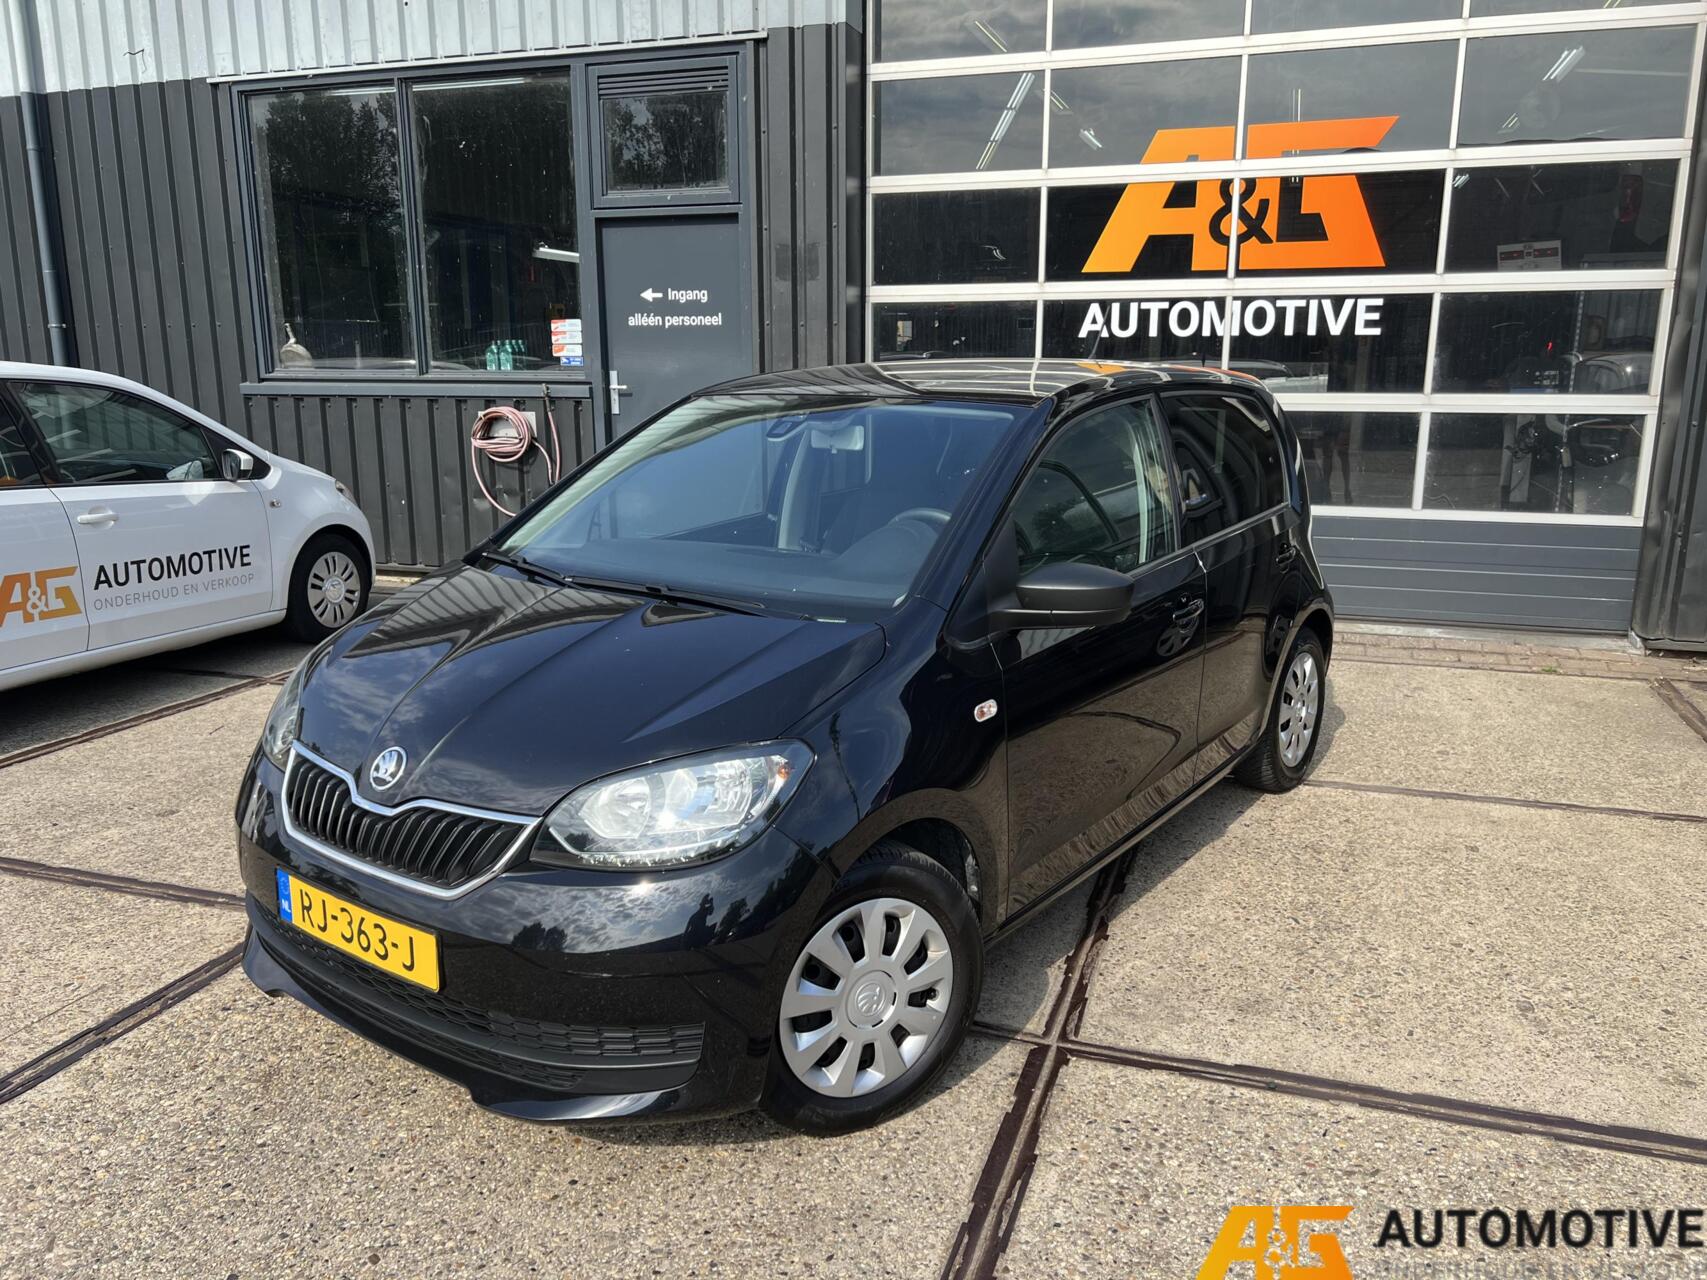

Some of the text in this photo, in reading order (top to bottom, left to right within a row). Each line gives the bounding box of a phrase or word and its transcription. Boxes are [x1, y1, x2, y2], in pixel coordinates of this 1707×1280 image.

[1081, 115, 1399, 273] A&G
[668, 287, 708, 303] Ingang
[628, 312, 722, 328] alléén personeel
[1078, 298, 1384, 339] AUTOMOTIVE
[93, 544, 252, 590] AUTOMOTIVE
[0, 565, 82, 628] A&G
[93, 573, 255, 611] ONDERHOUD EN VERKOOP
[300, 889, 415, 972] RJ-363-J
